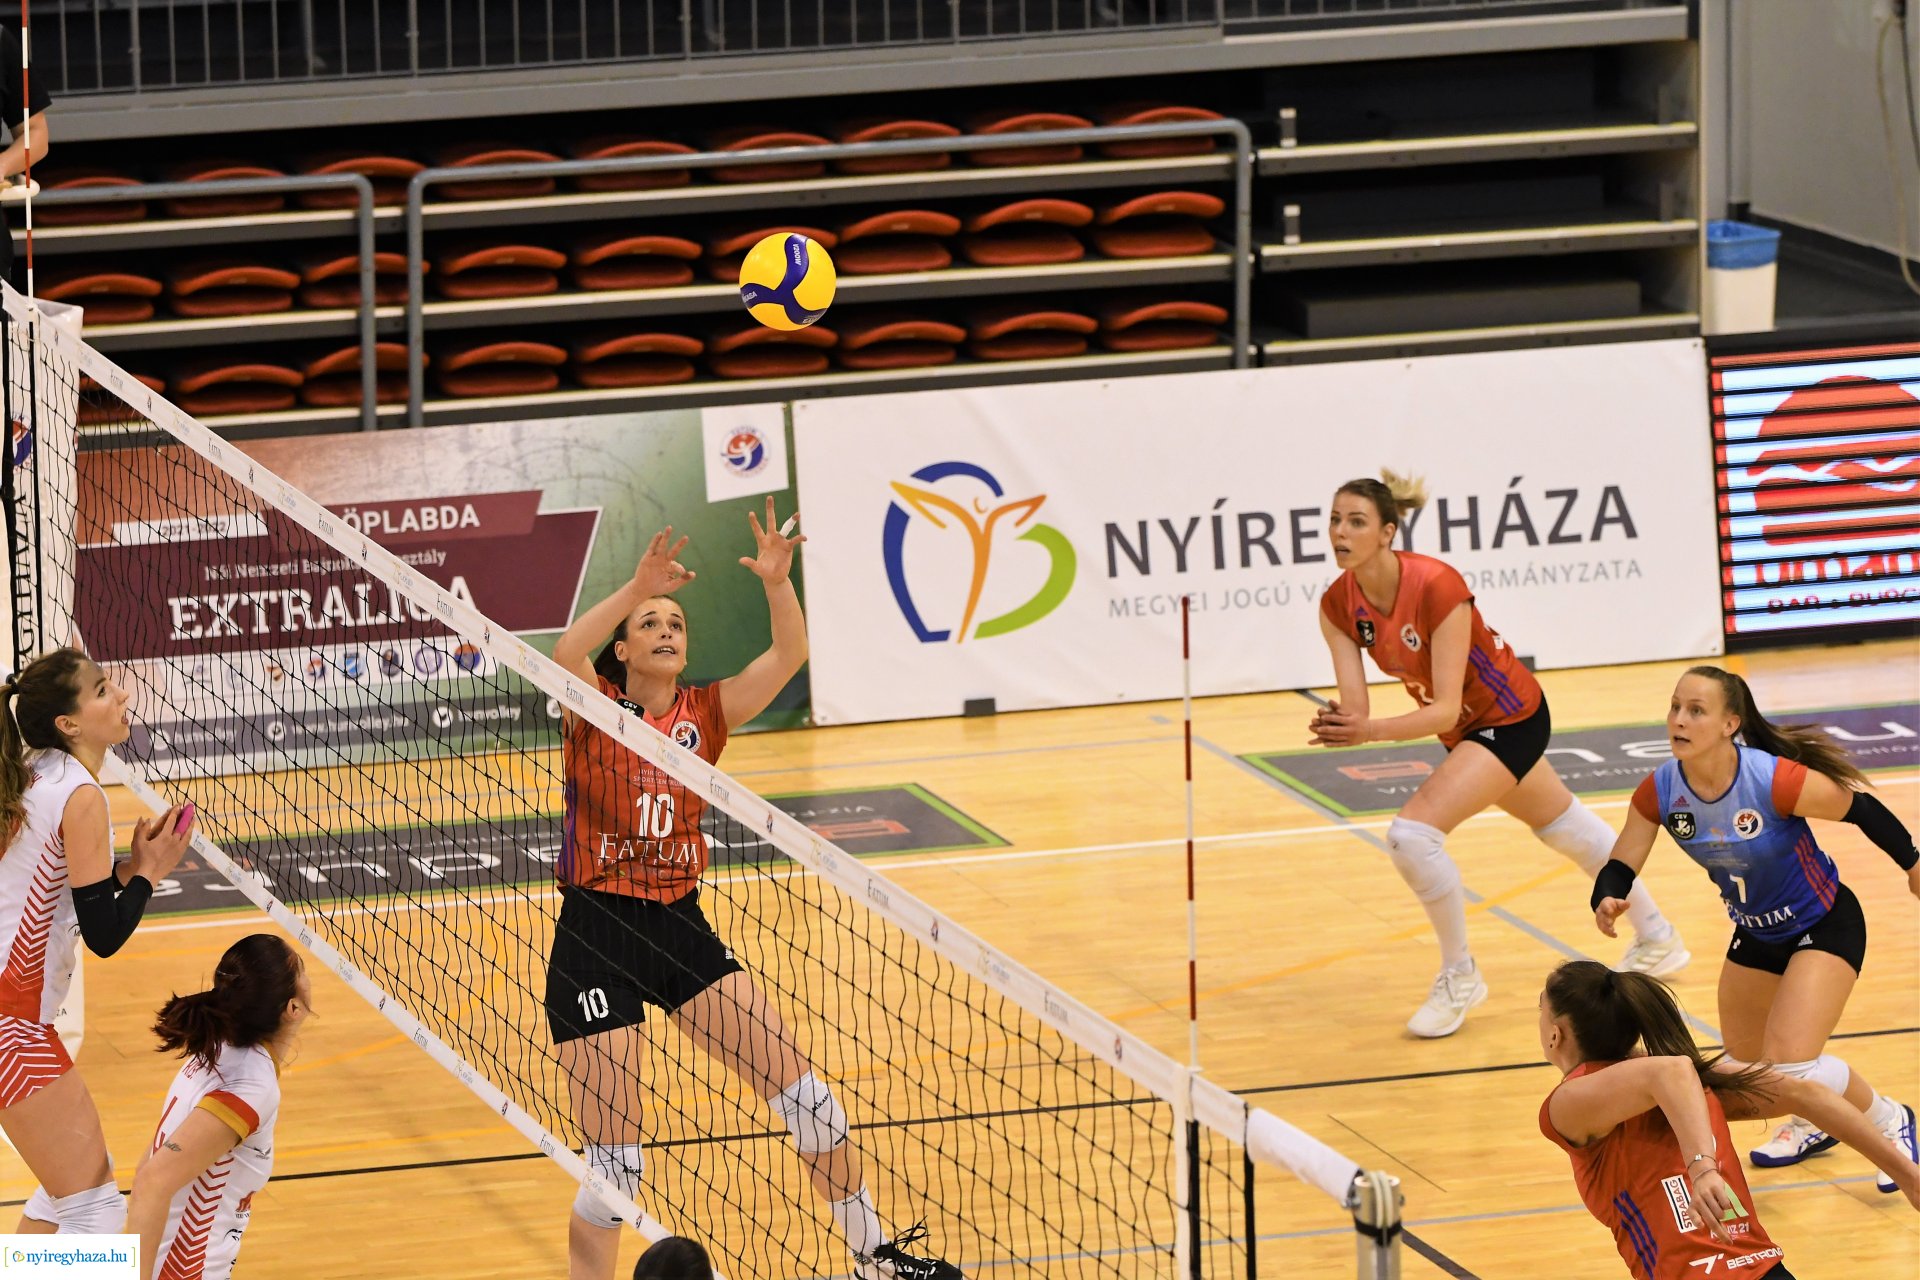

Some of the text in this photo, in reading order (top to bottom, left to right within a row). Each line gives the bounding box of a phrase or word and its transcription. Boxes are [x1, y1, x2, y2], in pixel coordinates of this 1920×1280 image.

[342, 503, 481, 536] ÖPLABDA
[1104, 475, 1639, 579] NYÍREYHÁZA
[398, 548, 447, 567] sztály
[1109, 592, 1208, 618] MEGYEI
[1220, 580, 1291, 610] JOGÚ
[636, 792, 675, 838] 10
[597, 832, 699, 864] FATUM
[577, 987, 609, 1022] 10
